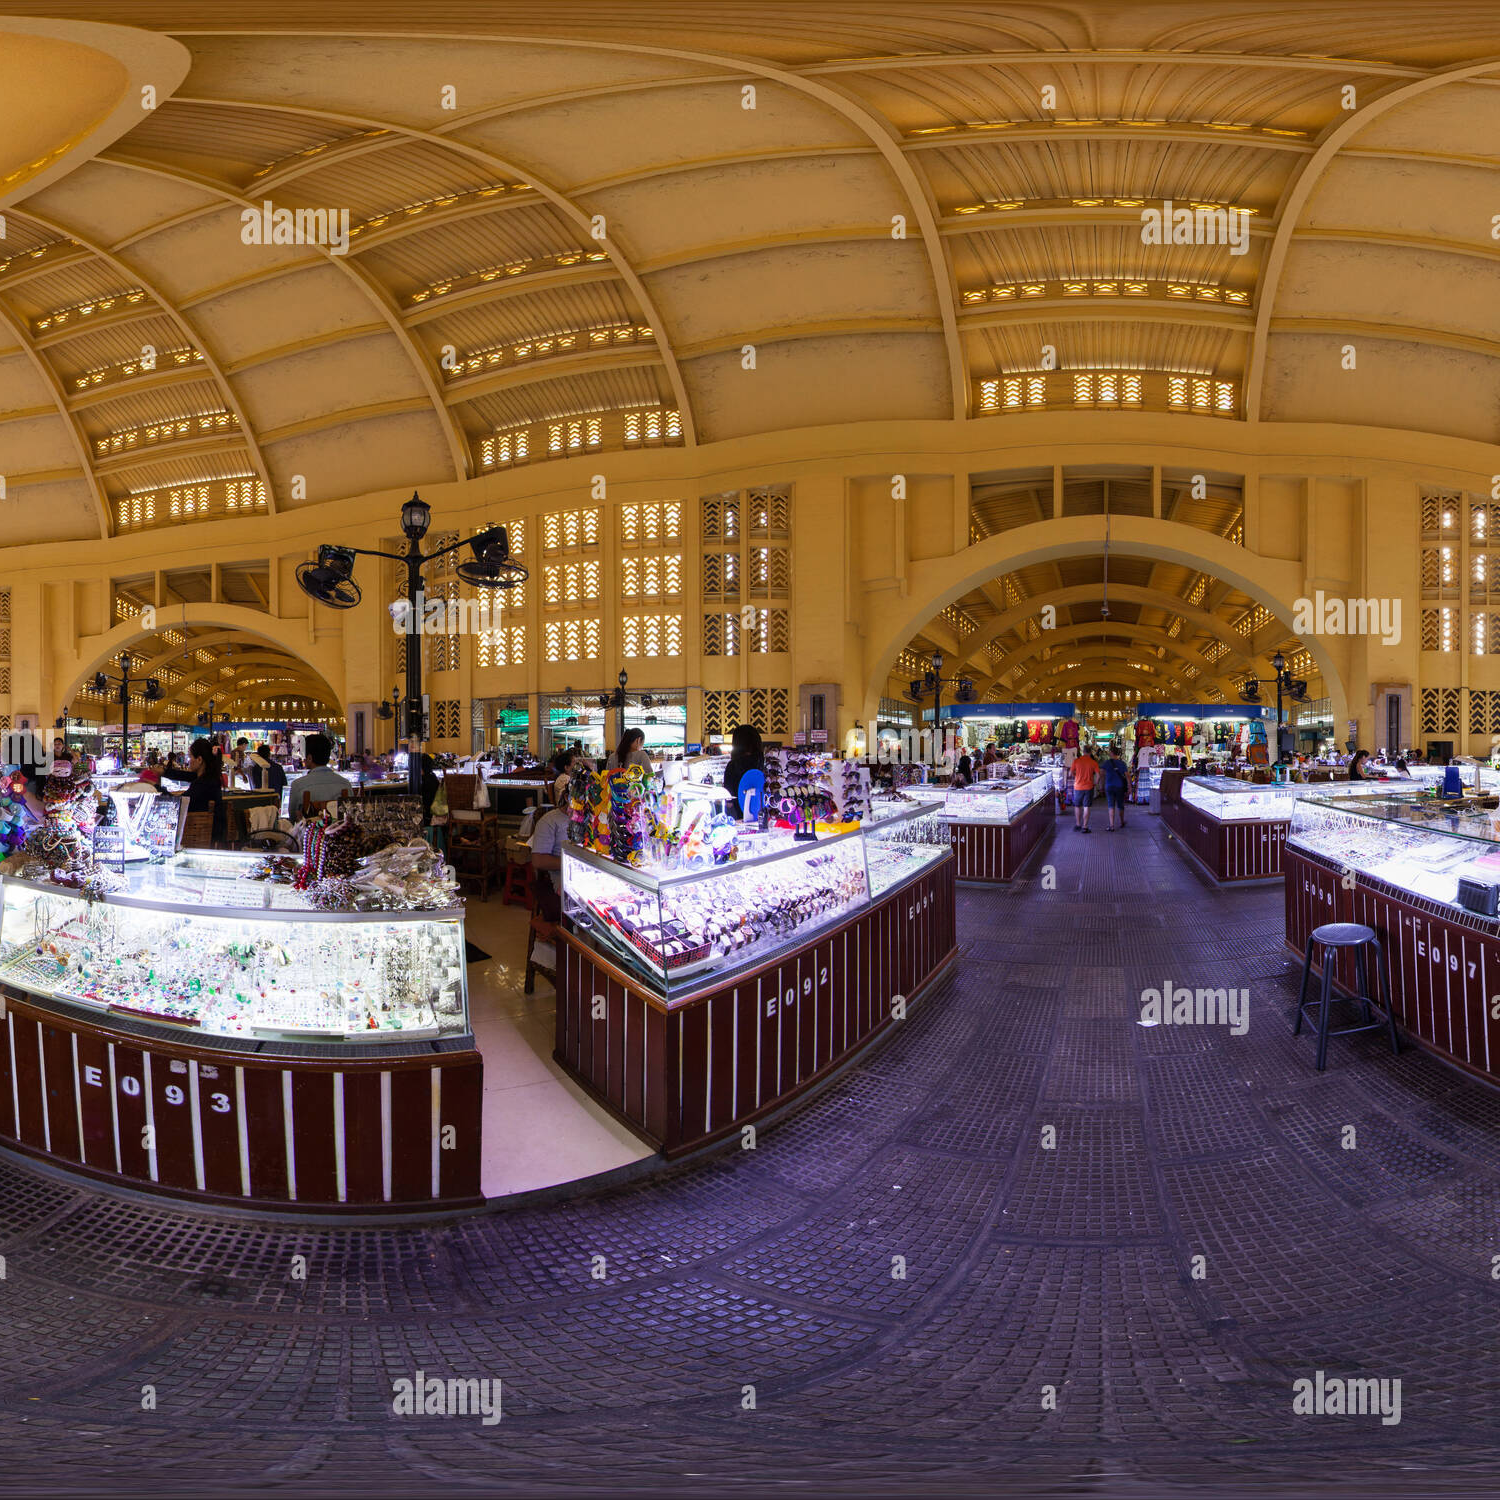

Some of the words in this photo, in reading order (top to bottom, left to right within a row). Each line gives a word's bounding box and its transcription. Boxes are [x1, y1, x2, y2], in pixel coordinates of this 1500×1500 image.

[951, 835, 965, 843] 04
[1262, 833, 1285, 841] E20
[909, 891, 934, 920] E091
[1305, 880, 1332, 906] E098
[1418, 941, 1476, 979] E097
[766, 967, 828, 1017] E092
[85, 1065, 231, 1113] E093
